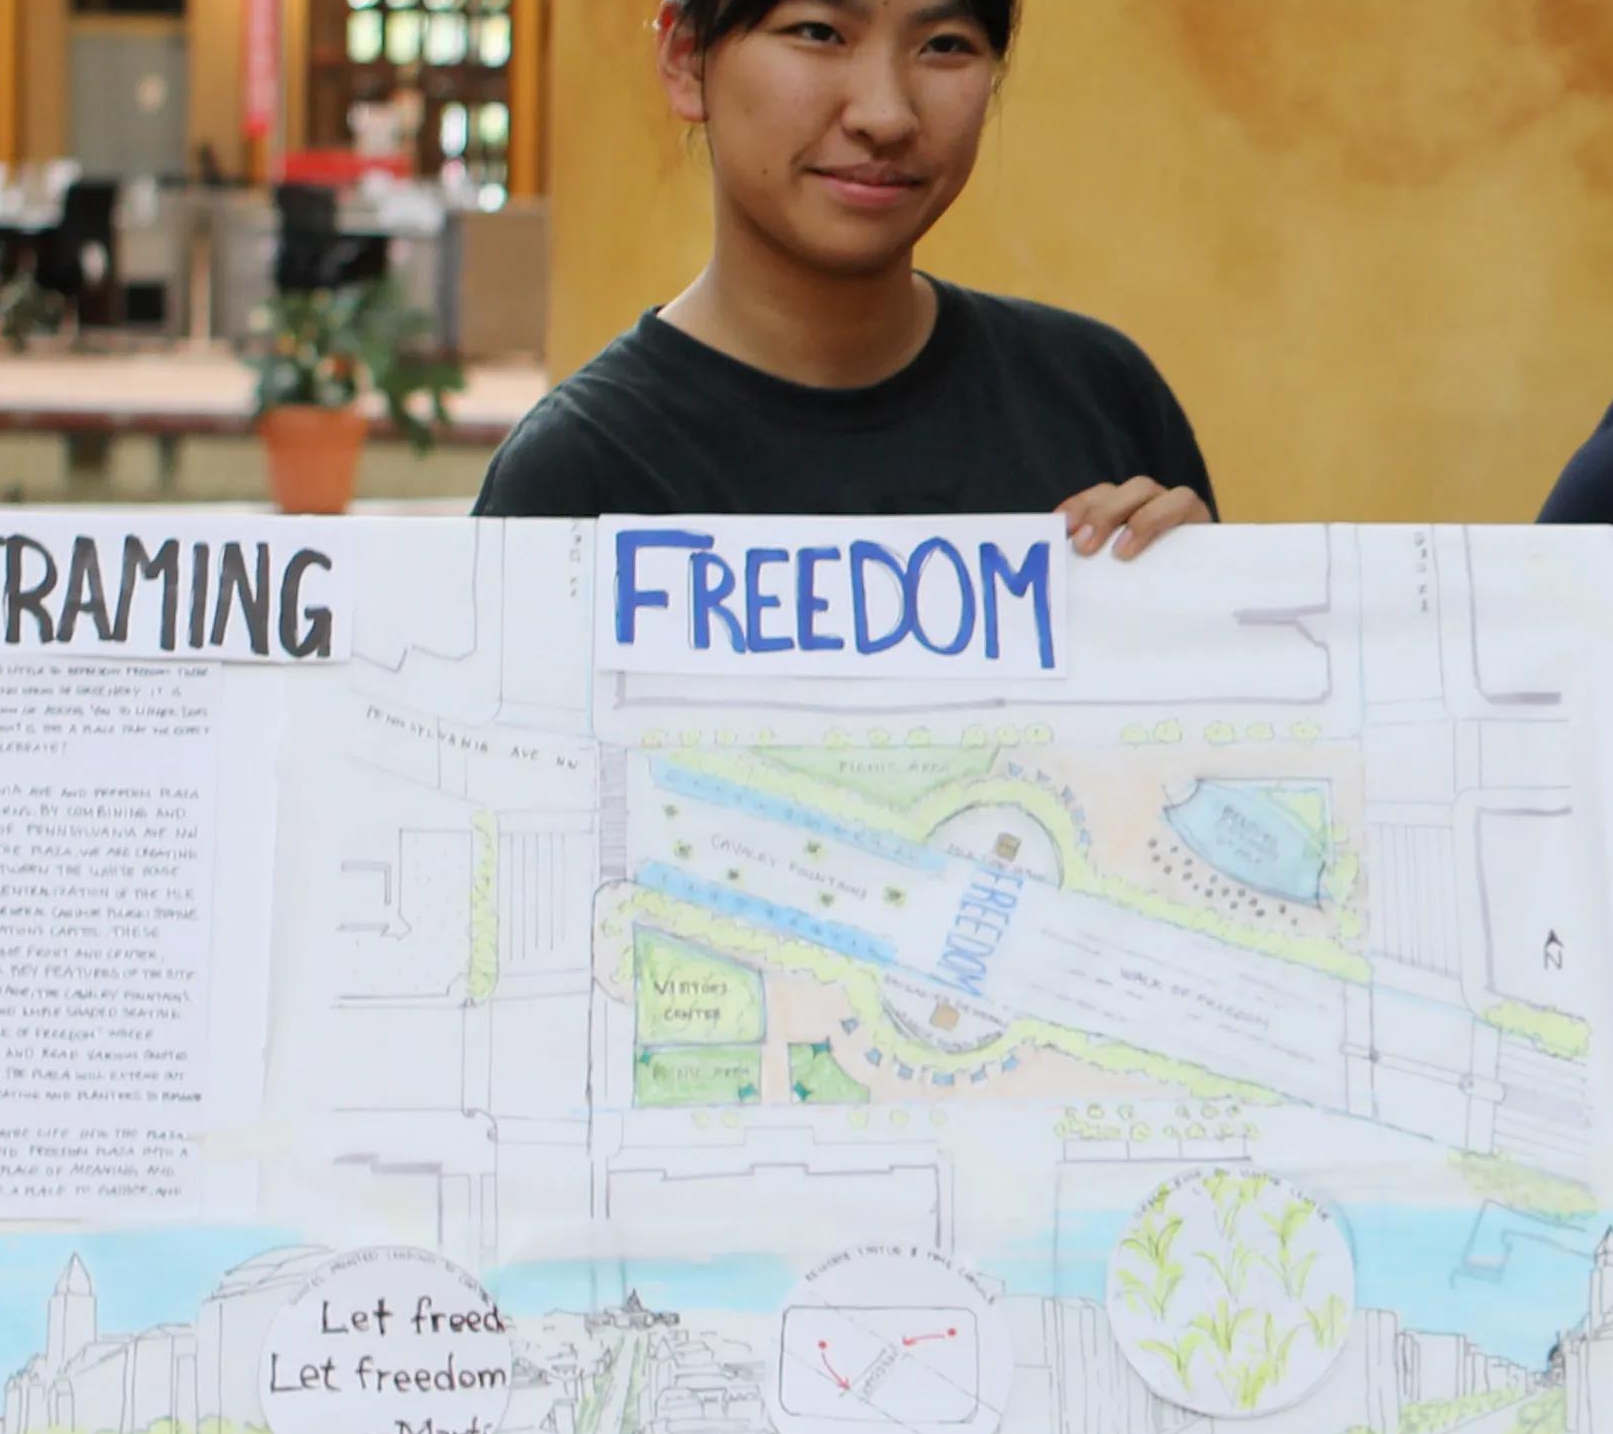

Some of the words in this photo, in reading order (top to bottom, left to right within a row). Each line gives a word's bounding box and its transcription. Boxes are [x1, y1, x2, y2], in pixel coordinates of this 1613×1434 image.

[614, 529, 1057, 670] FREEDOM
[510, 745, 540, 761] AVE
[711, 833, 776, 867] CAVALRY
[937, 863, 1025, 997] FREEDOM
[663, 1007, 721, 1022] CENTER
[320, 1297, 393, 1337] Let
[411, 1295, 506, 1335] freed
[270, 1352, 341, 1394] Let
[355, 1352, 506, 1393] freedom
